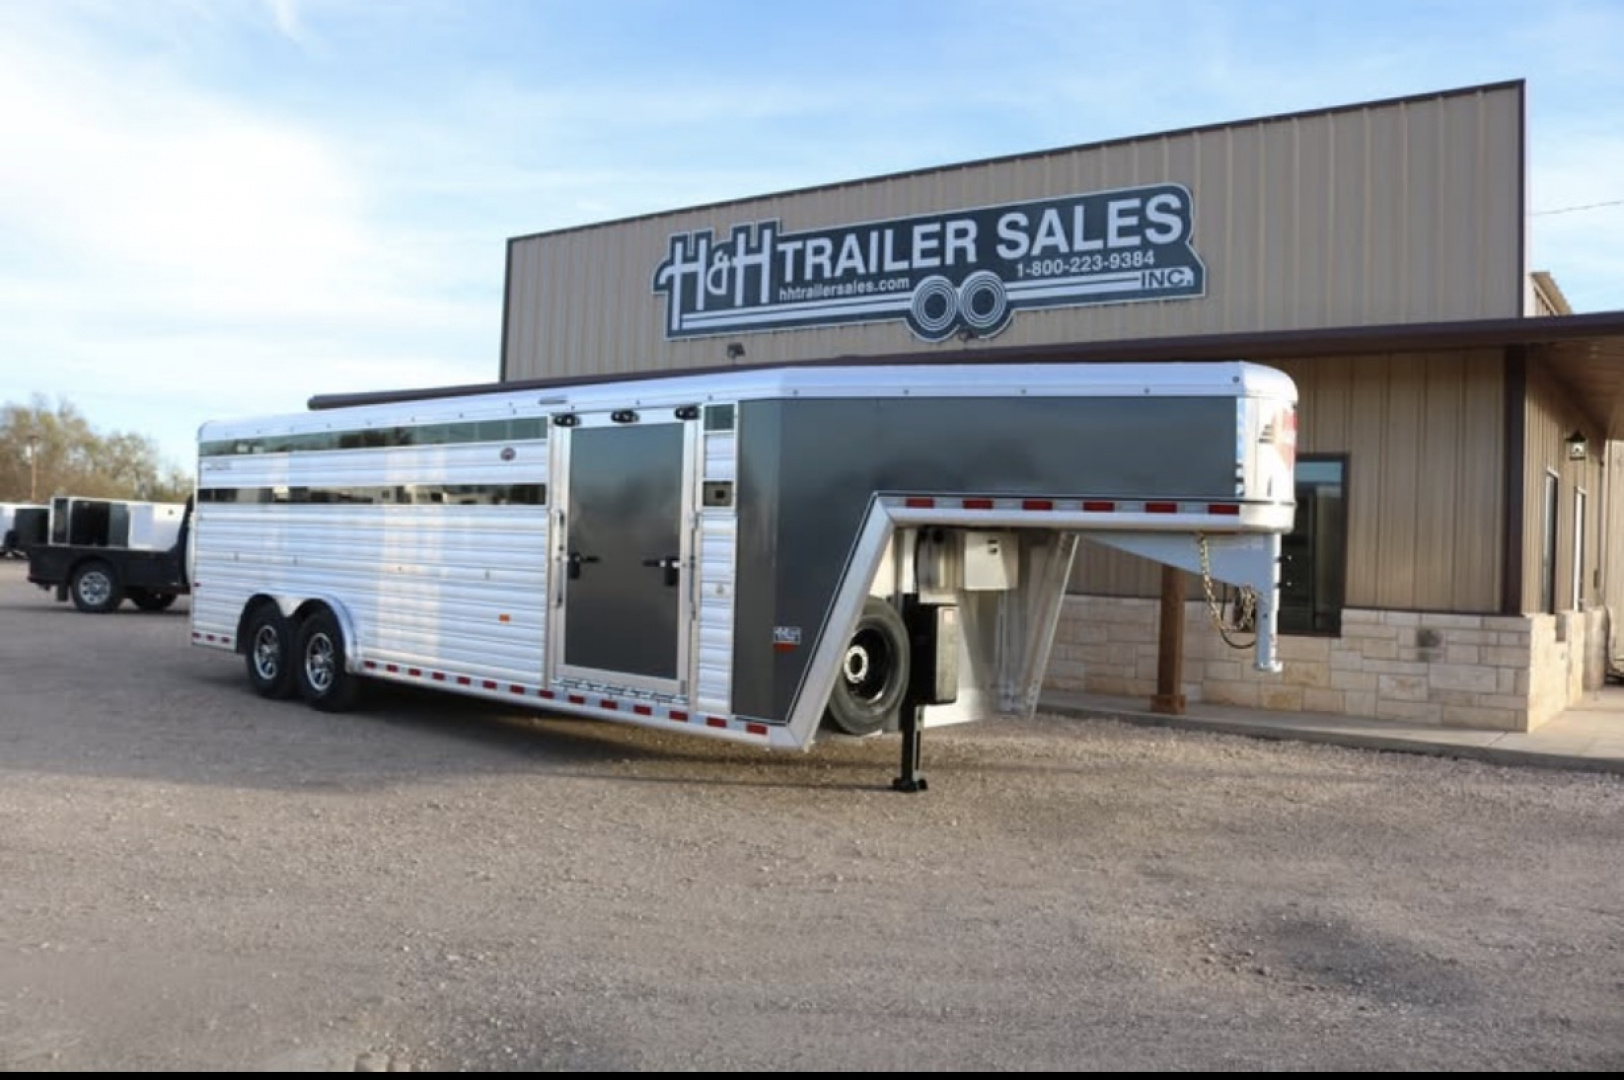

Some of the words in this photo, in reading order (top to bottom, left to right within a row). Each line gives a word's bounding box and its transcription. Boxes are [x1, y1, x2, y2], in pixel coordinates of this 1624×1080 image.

[658, 228, 772, 331] H&H
[777, 218, 978, 284] TRAILER
[995, 193, 1184, 261] SALES
[1016, 249, 1156, 278] 1-800-223-9384
[779, 276, 910, 302] hhtrailersales.com
[1140, 268, 1193, 289] INC.
